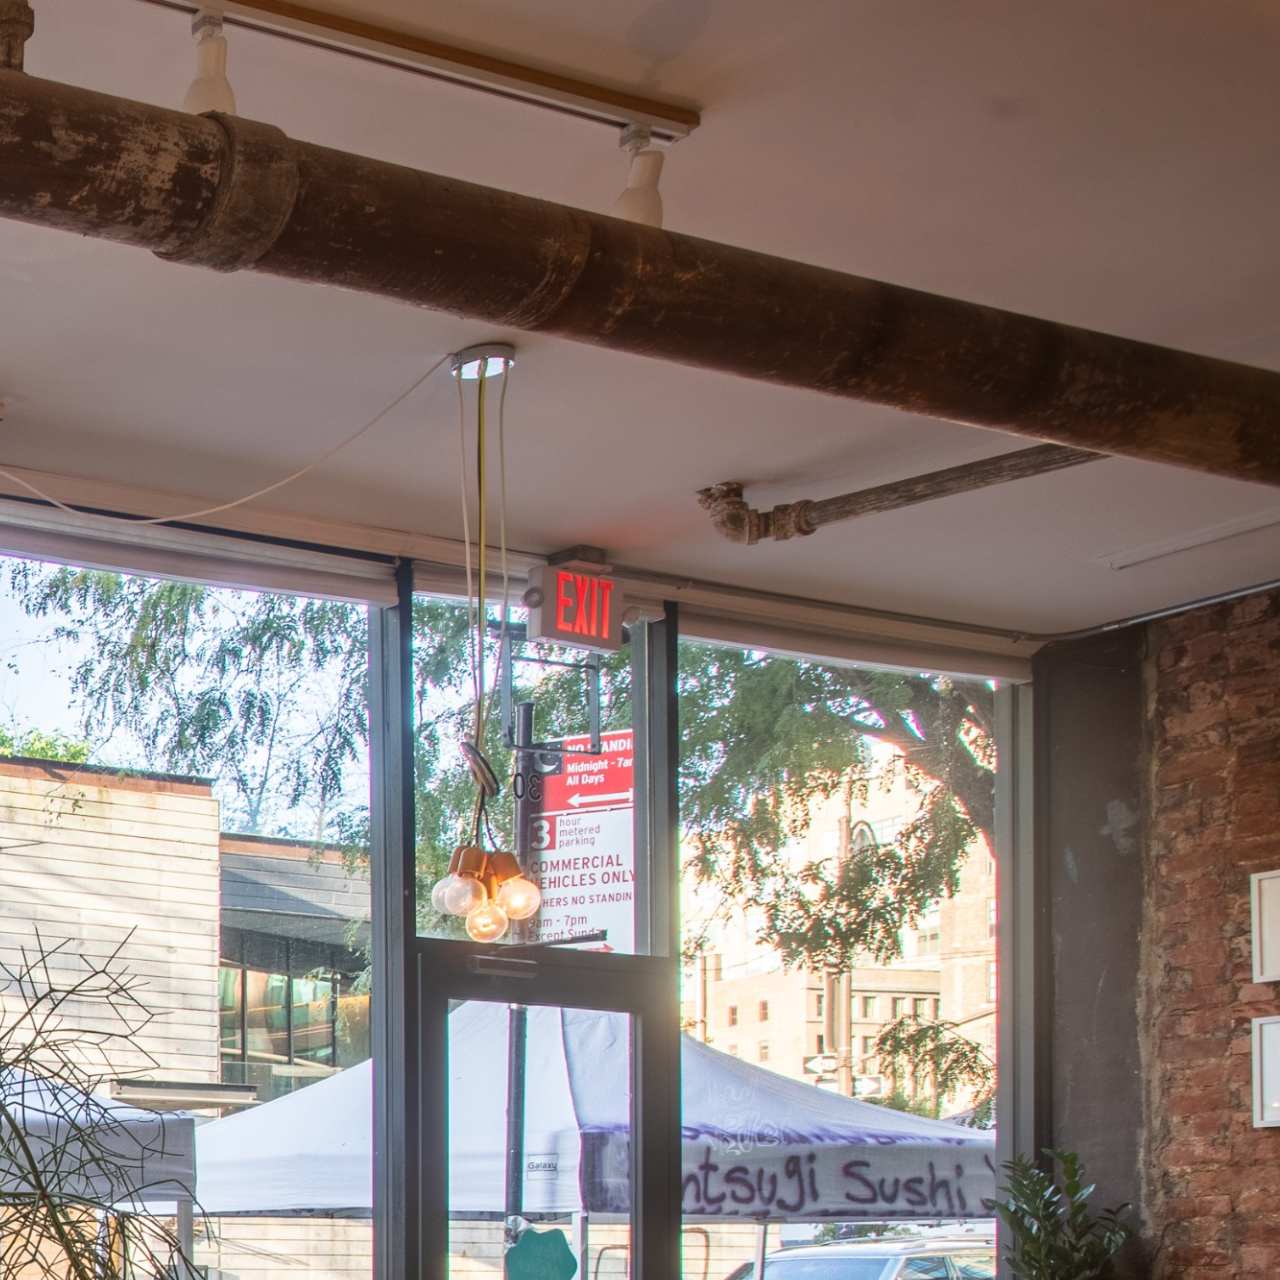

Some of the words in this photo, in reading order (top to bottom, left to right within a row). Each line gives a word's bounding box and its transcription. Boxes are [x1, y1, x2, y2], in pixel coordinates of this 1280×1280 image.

[555, 570, 615, 640] EXIT
[587, 738, 633, 753] ANDI
[567, 759, 609, 773] Midnight
[566, 776, 580, 786] All
[581, 773, 605, 785] Days
[559, 817, 582, 827] hour
[530, 819, 551, 850] 3
[559, 825, 601, 837] metered
[559, 836, 596, 849] parking
[530, 854, 624, 874] COMMERCIAL
[542, 896, 569, 908] HERS
[571, 895, 586, 905] NO
[588, 892, 632, 904] STANDIN
[565, 914, 588, 928] 7pm
[681, 1145, 819, 1213] ntsugi
[841, 1159, 968, 1212] Sushi
